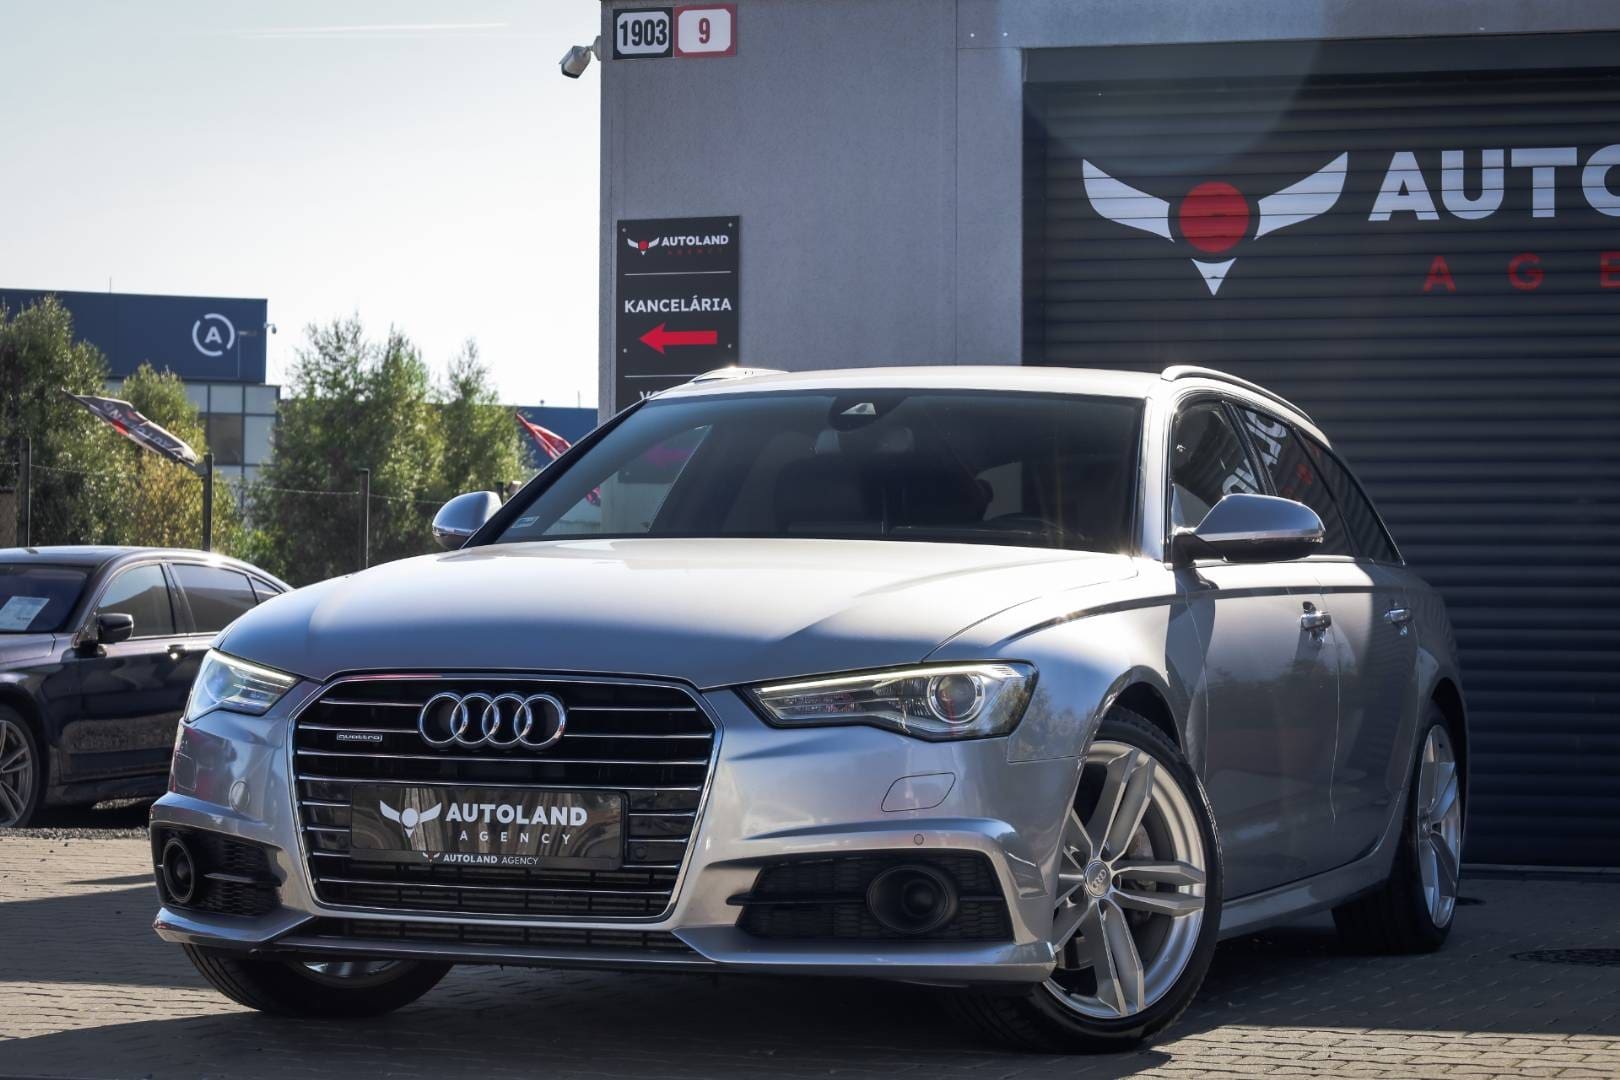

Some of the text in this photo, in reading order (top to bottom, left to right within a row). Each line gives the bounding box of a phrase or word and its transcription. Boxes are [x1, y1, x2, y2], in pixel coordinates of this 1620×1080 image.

[619, 19, 668, 46] 1903
[698, 18, 711, 44] 9
[661, 235, 729, 247] AUTOLAND
[624, 295, 732, 313] KANCELÁRIA
[445, 802, 588, 826] AUTOLAND
[459, 830, 572, 845] AGENCY
[443, 853, 540, 865] AUTOLAND AGENCY
